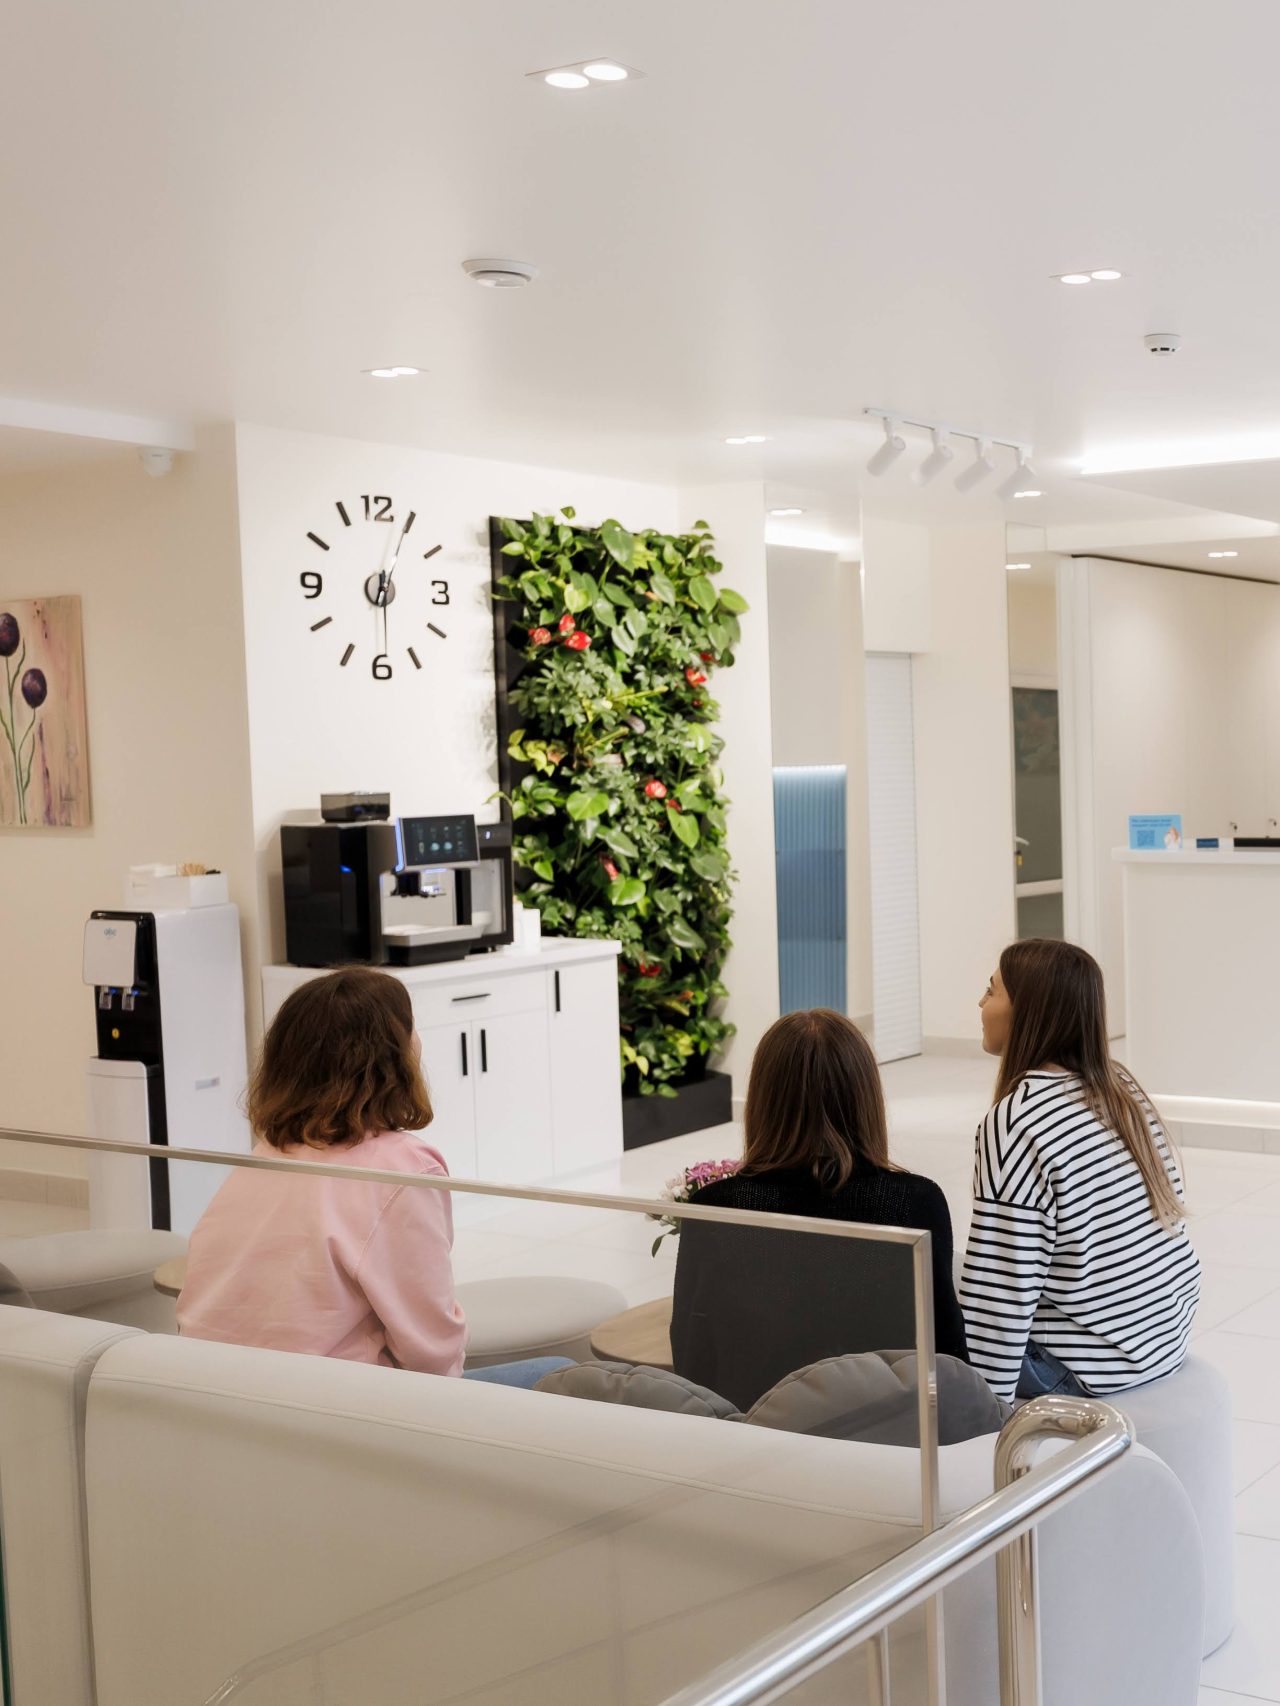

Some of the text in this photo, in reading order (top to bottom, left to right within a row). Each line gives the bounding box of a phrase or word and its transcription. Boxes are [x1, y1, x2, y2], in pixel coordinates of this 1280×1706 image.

[360, 495, 394, 522] 12
[300, 572, 322, 599] 9
[431, 581, 450, 605] 3
[372, 654, 392, 680] 6
